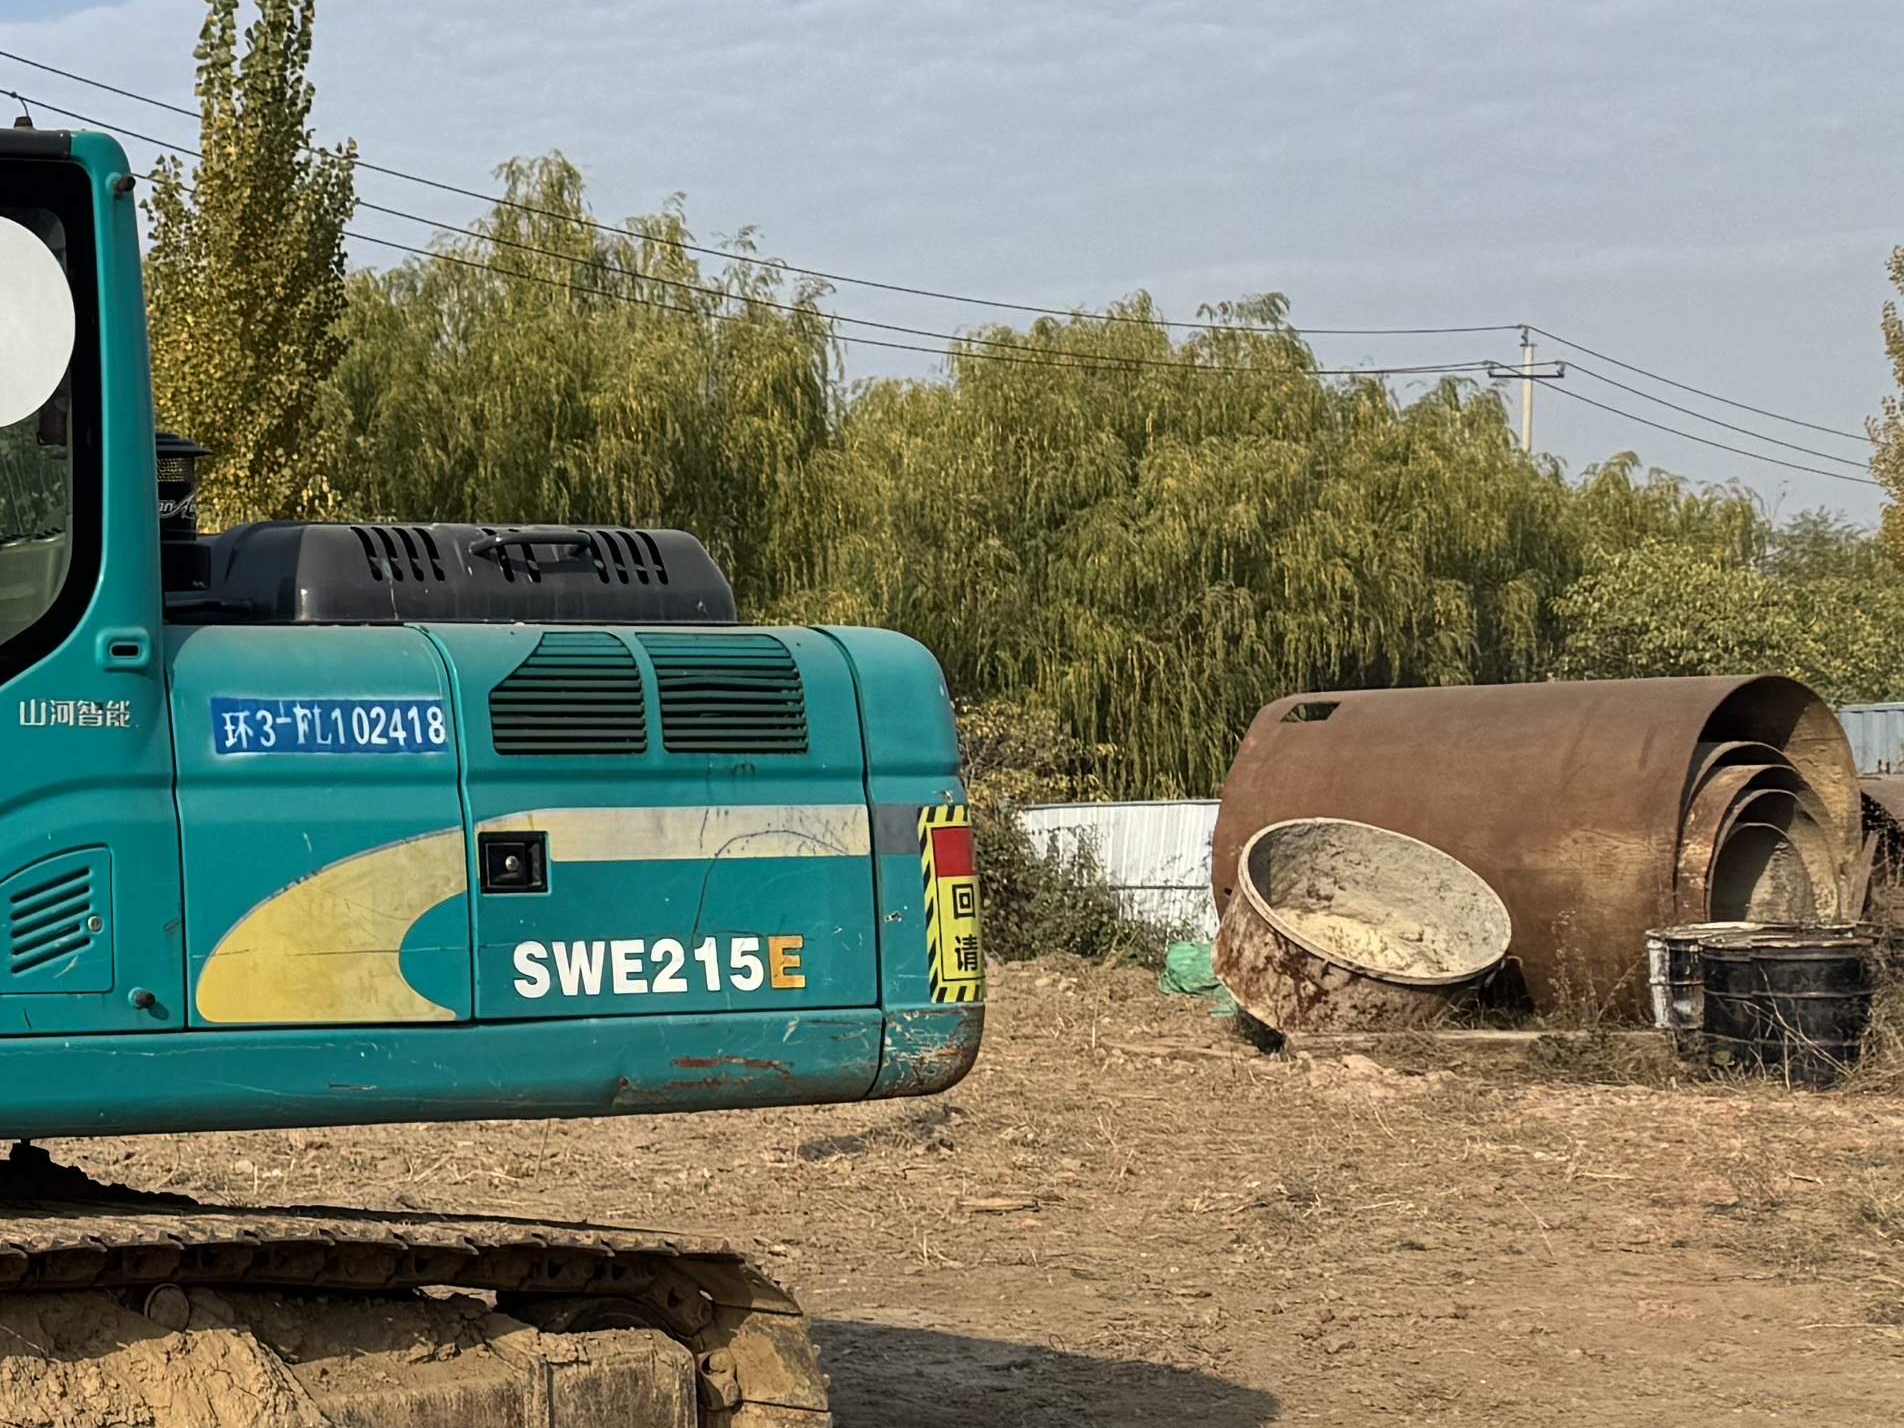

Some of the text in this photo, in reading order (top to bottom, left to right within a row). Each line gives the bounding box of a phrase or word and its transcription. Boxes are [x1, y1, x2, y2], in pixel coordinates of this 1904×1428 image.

[19, 699, 131, 727] 山河智能
[952, 883, 976, 919] 回
[513, 935, 806, 999] SWE215E
[954, 934, 978, 972] 请
